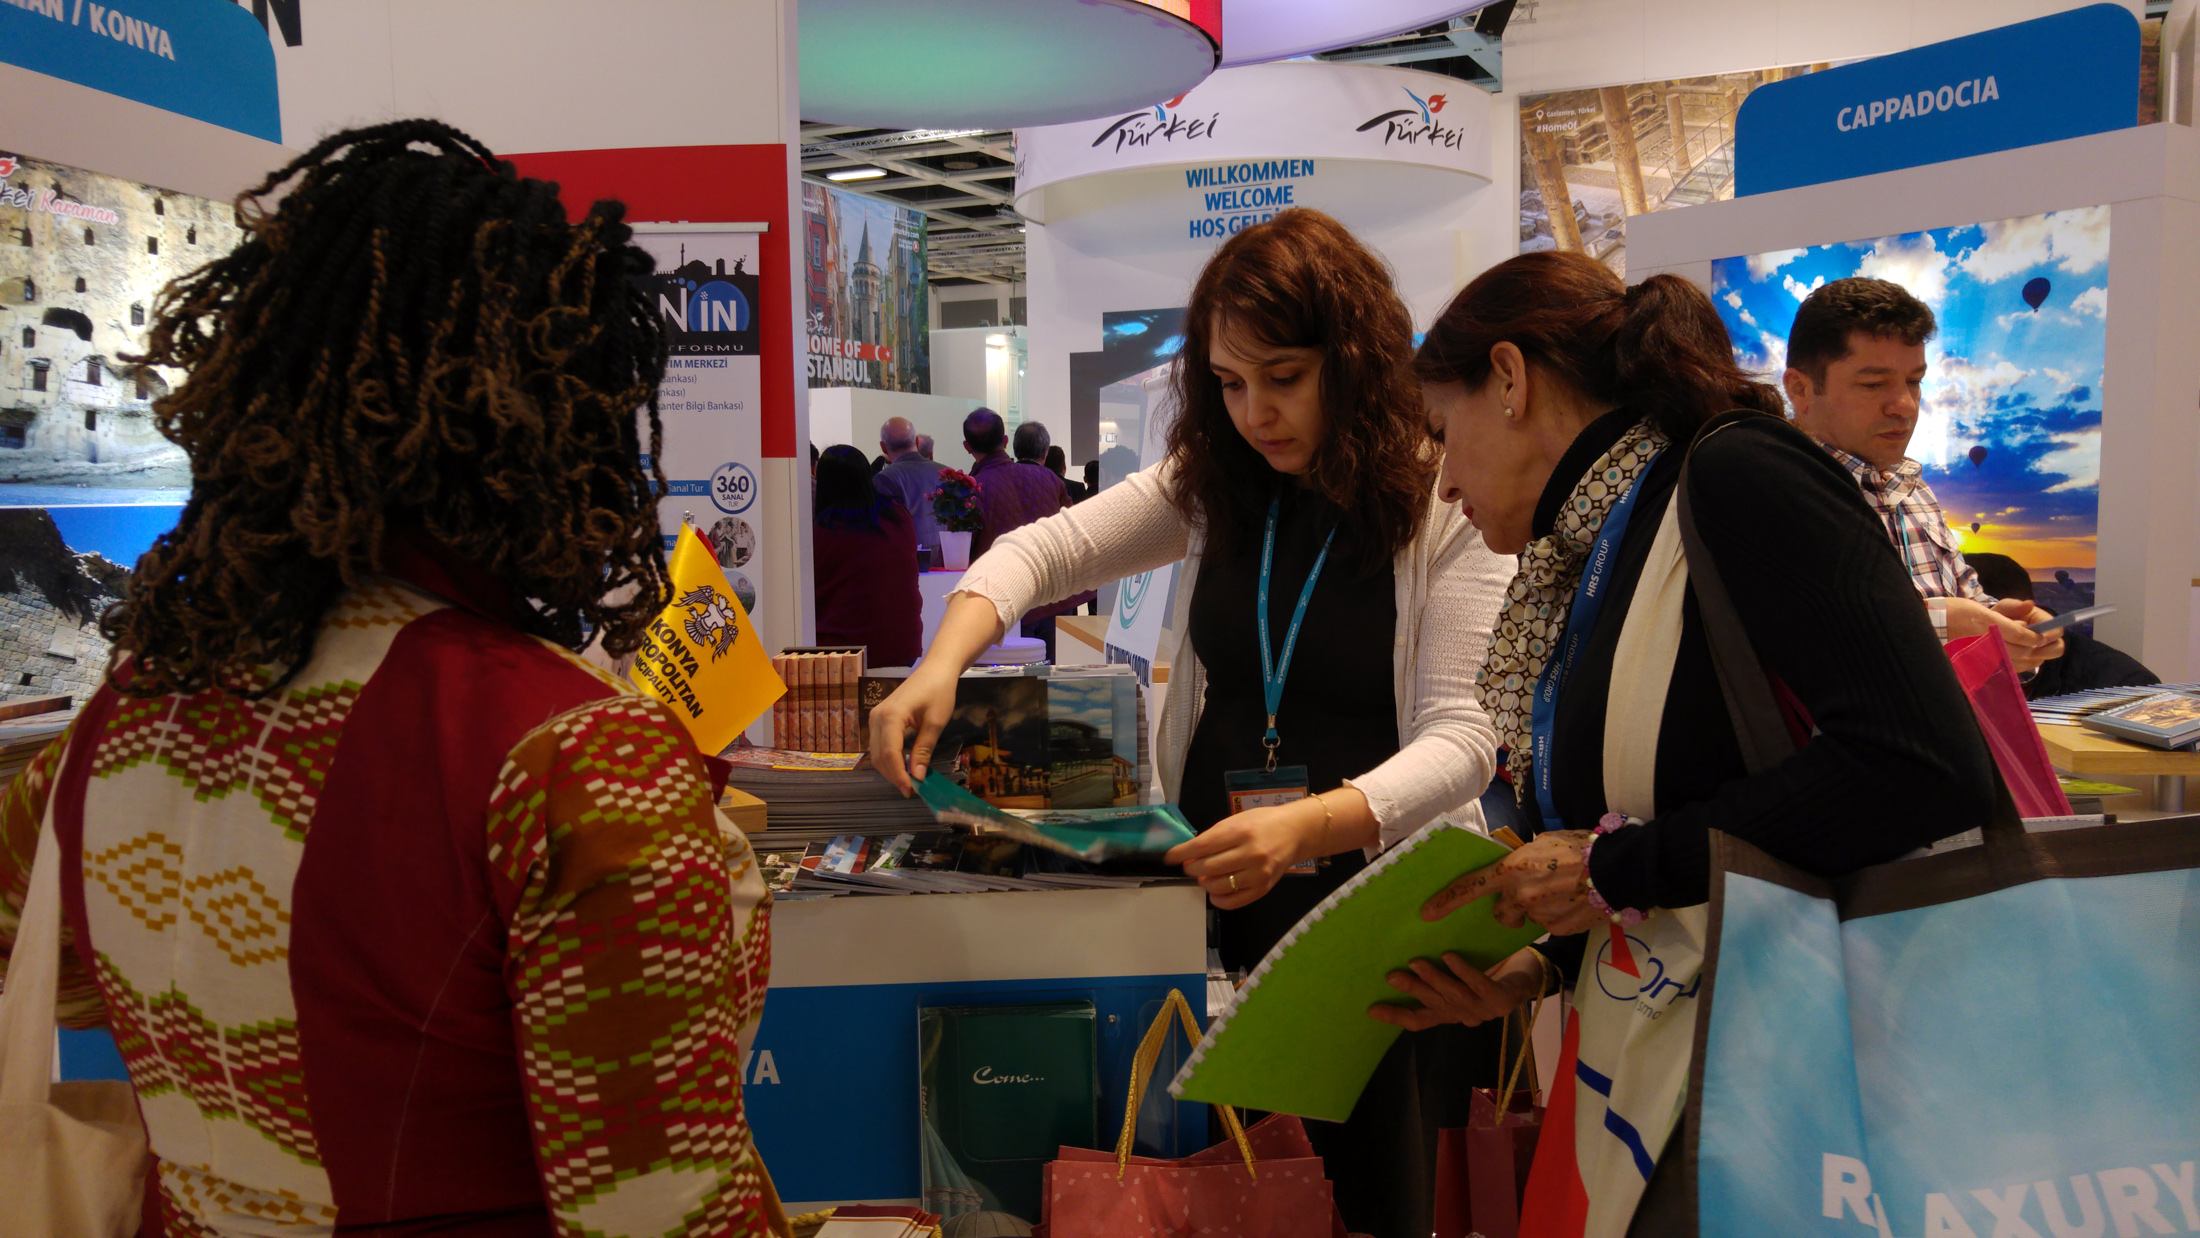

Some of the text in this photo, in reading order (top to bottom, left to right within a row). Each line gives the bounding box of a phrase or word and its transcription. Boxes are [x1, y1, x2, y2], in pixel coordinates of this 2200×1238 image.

[89, 2, 175, 61] KONYA
[1836, 75, 2000, 132] CAPPADOCIA
[1091, 111, 1220, 154] Türkei
[1356, 108, 1464, 151] Türkei
[1536, 120, 1578, 133] #HomeOf
[1186, 159, 1315, 188] WILLKOMMEN
[39, 187, 119, 226] Karaman
[1205, 185, 1294, 212] WELCOME
[1189, 218, 1225, 239] HOŞ
[685, 357, 728, 369] MERKEZİ
[844, 340, 862, 358] OF
[686, 400, 706, 412] Bilgi
[708, 400, 744, 412] Bankası)
[690, 484, 704, 493] Tur
[717, 475, 749, 493] 360
[722, 493, 744, 501] SANAL
[1586, 539, 1610, 598] HRS GROUP
[650, 618, 700, 679] KONYA
[1565, 633, 1579, 671] GROUP
